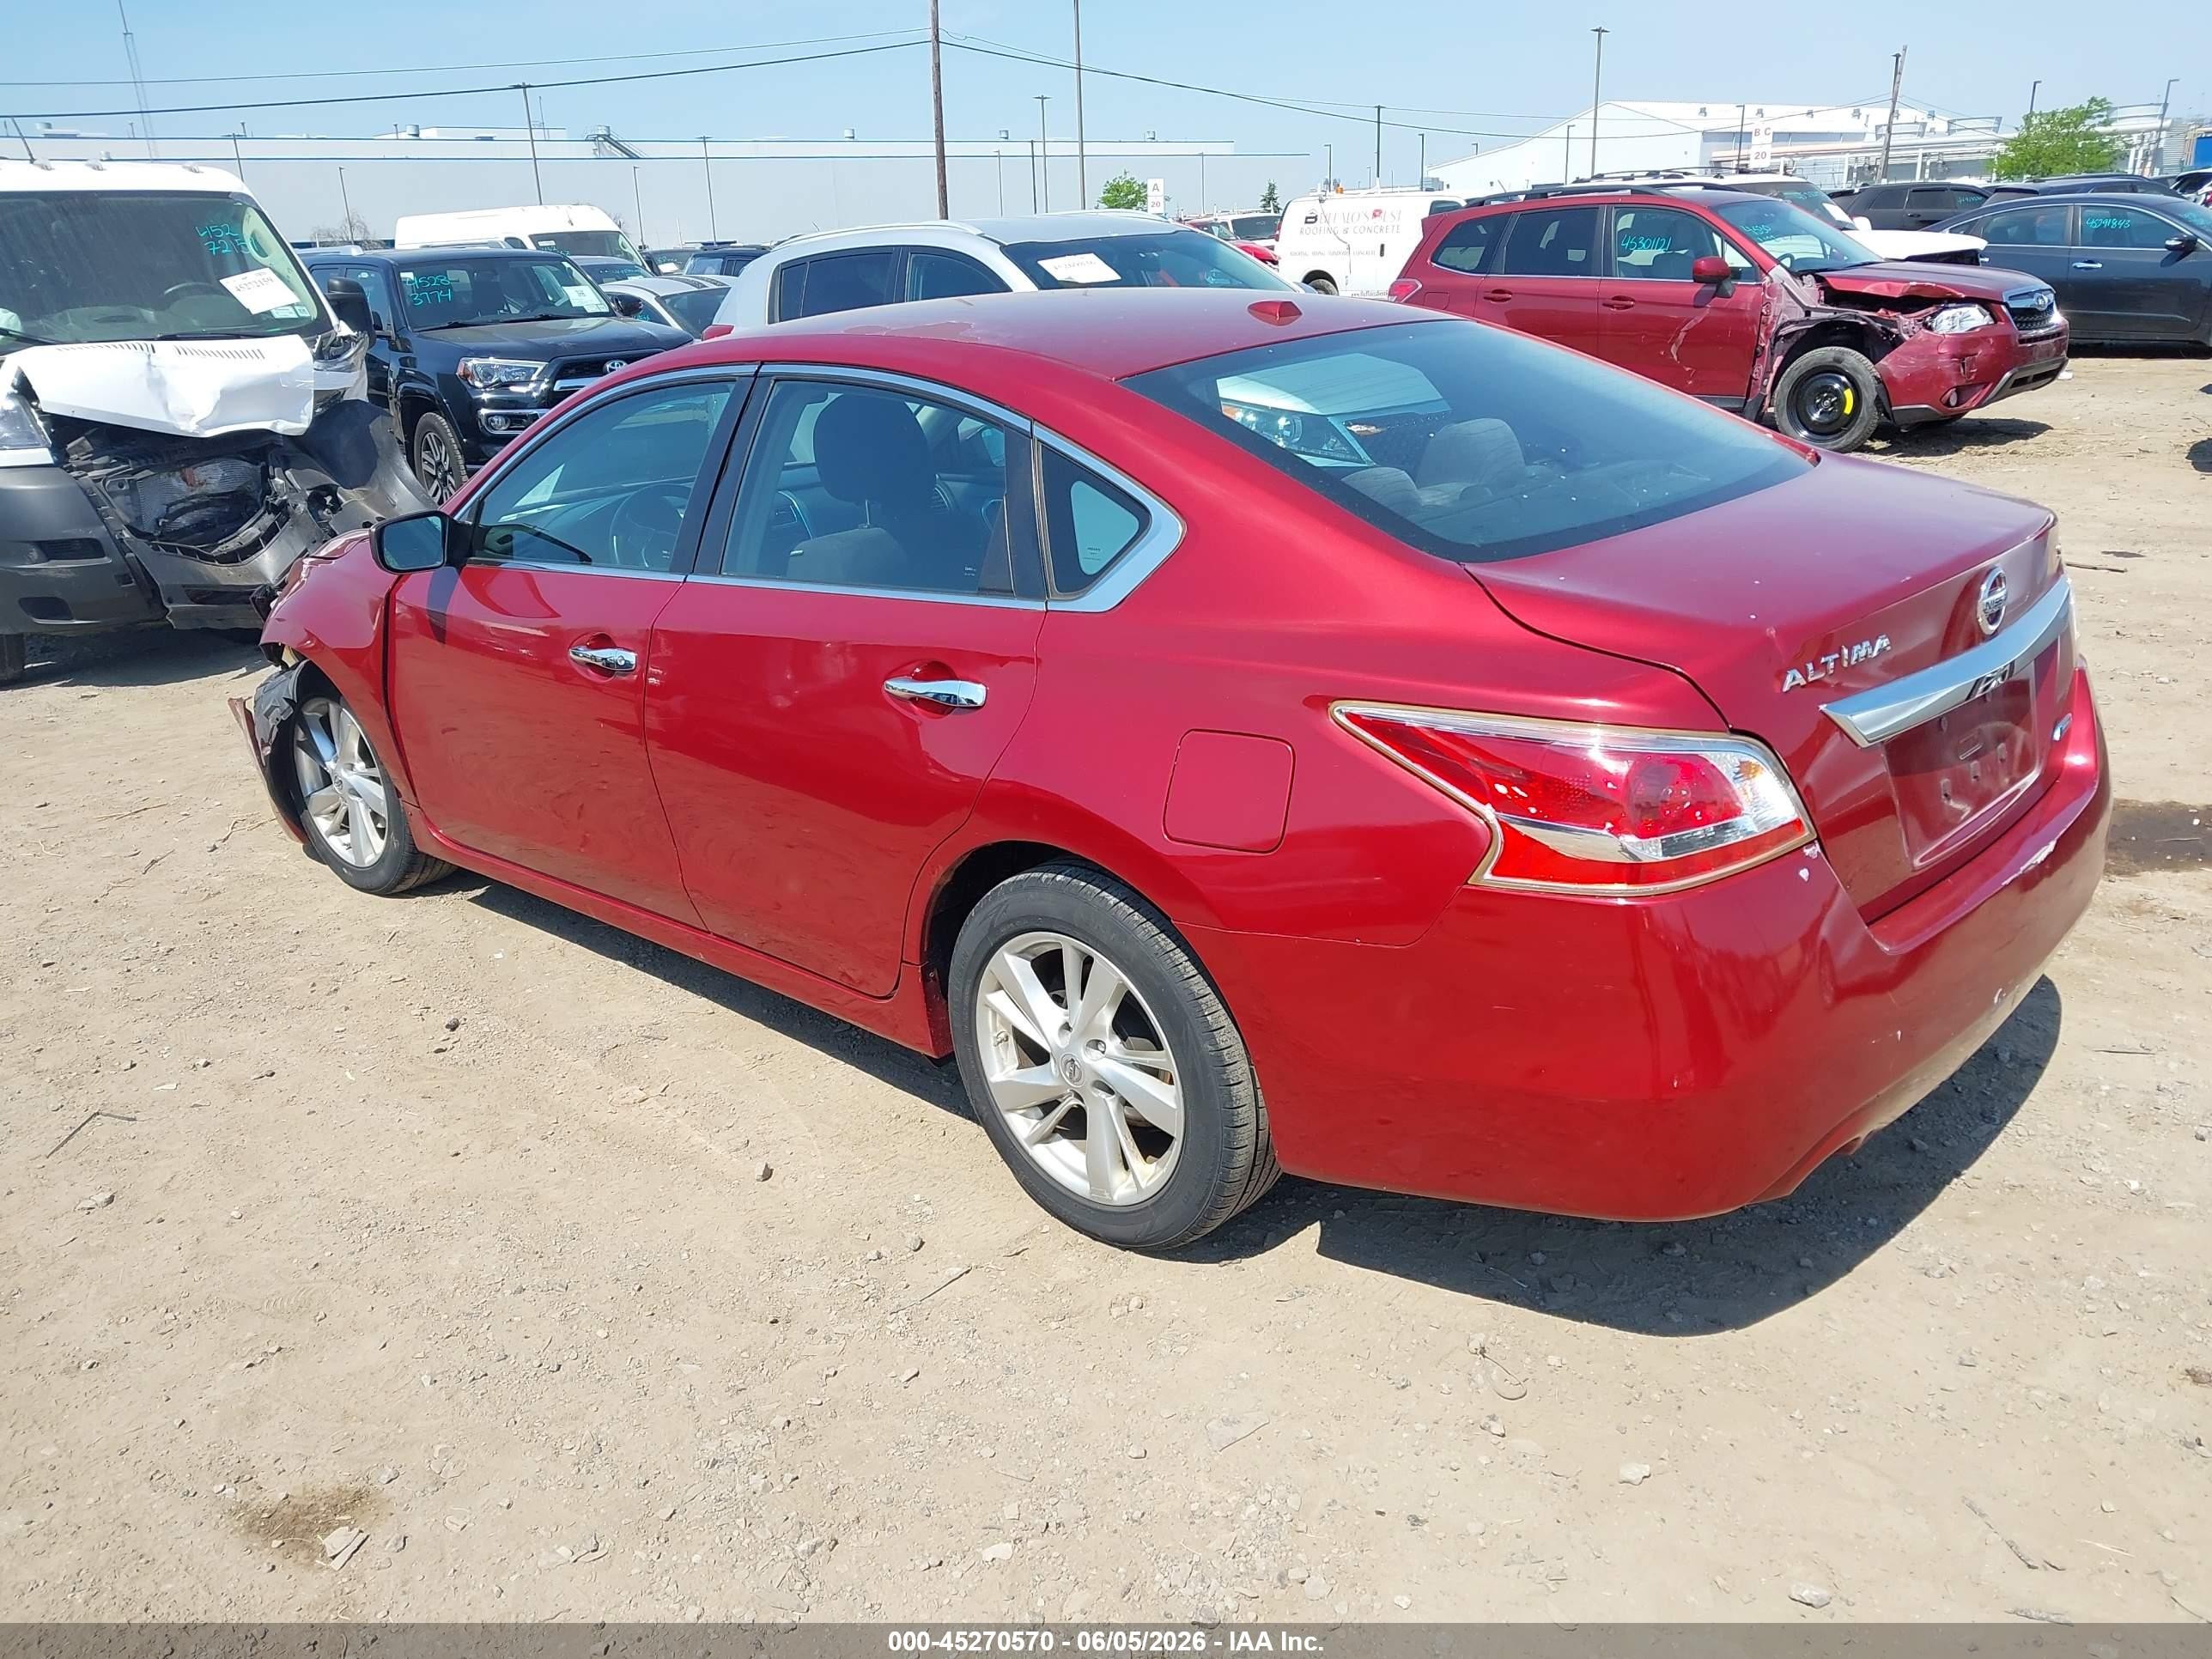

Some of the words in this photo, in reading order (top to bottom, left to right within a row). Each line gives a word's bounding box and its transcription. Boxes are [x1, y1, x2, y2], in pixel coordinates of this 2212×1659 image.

[1753, 128, 1761, 137] B
[1764, 127, 1771, 136] C
[1753, 151, 1767, 160] 20
[1152, 183, 1160, 192] A
[196, 224, 240, 239] 452
[1352, 224, 1401, 234] CONCRETE
[1621, 234, 1672, 251] 45301121
[406, 275, 451, 289] 4528
[410, 289, 452, 306] 3774
[1782, 635, 1892, 693] ALTIMA
